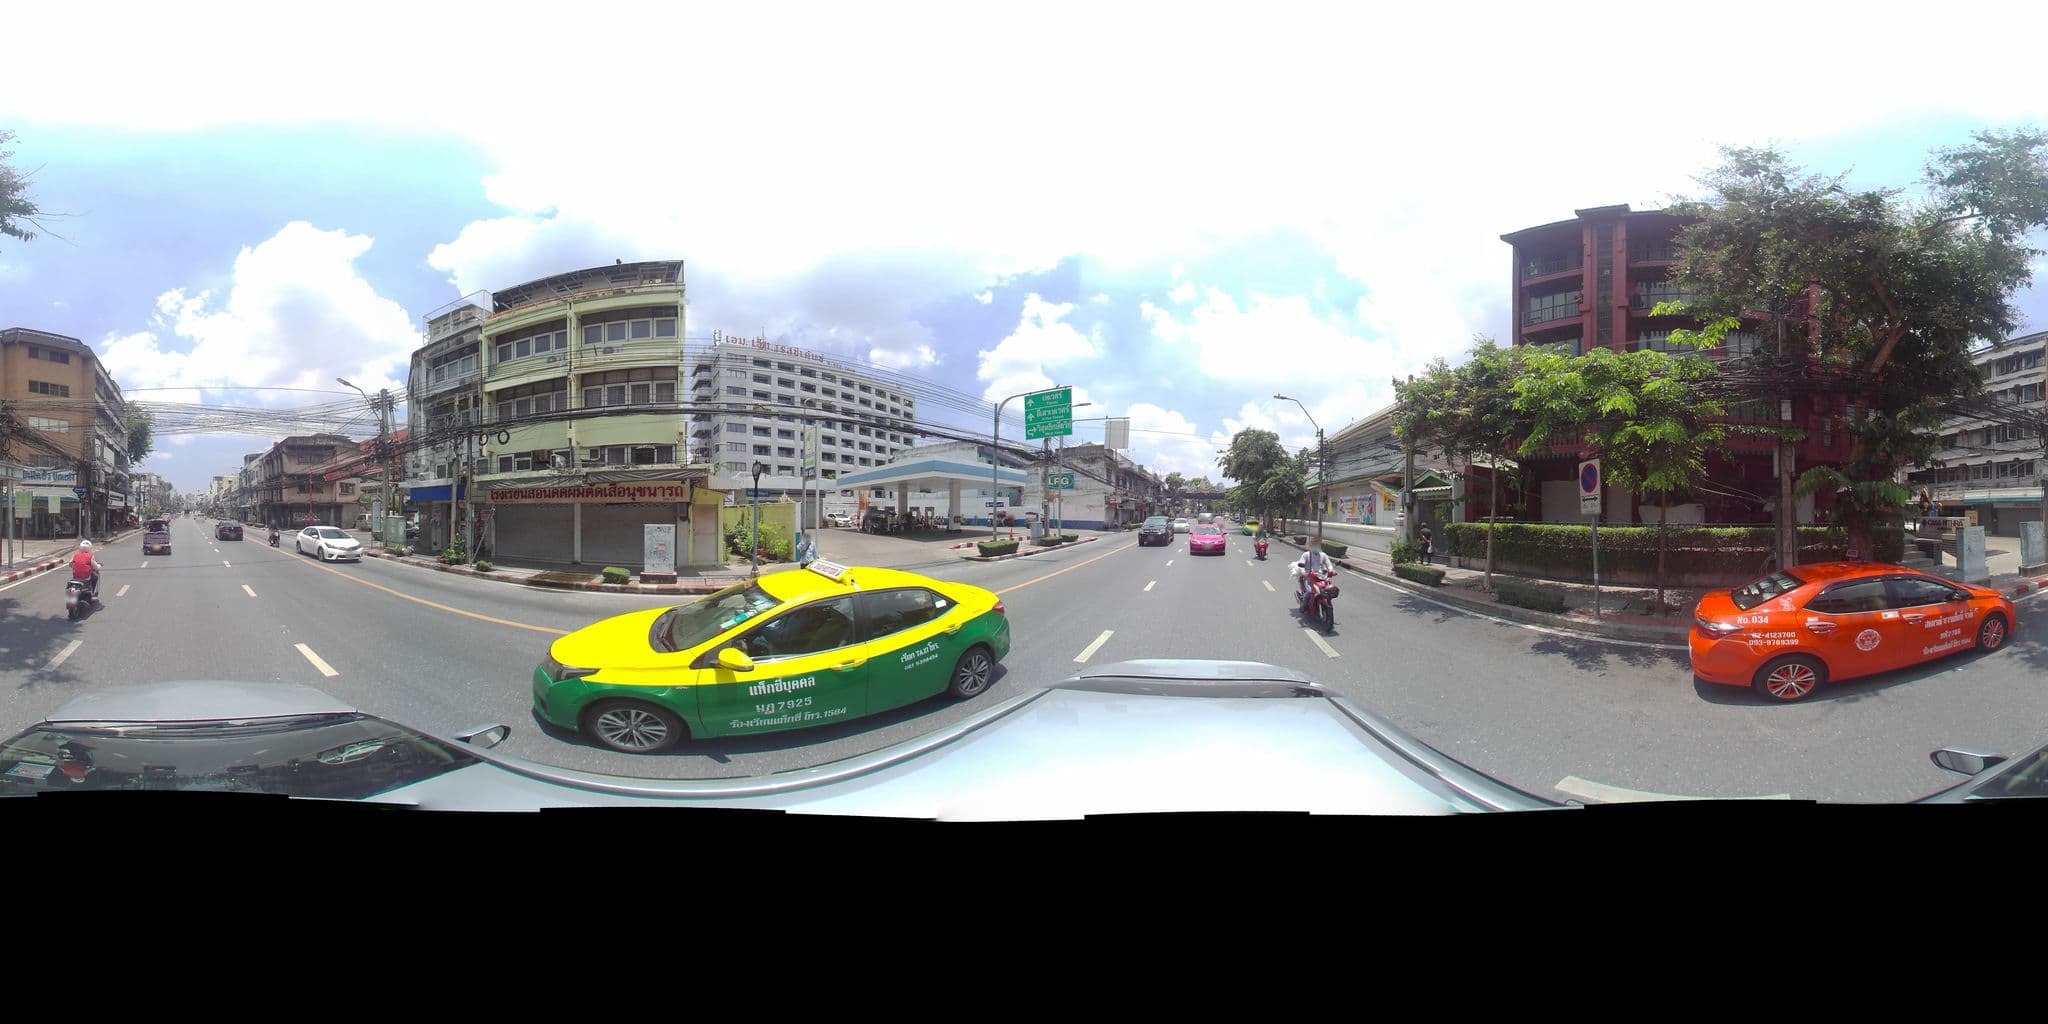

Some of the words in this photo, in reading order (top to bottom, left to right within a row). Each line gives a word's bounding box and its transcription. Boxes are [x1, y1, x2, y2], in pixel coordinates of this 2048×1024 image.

[1049, 477, 1069, 486] LPG
[1751, 615, 1769, 624] 034
[915, 646, 929, 657] TAXI
[777, 696, 812, 711] 7925
